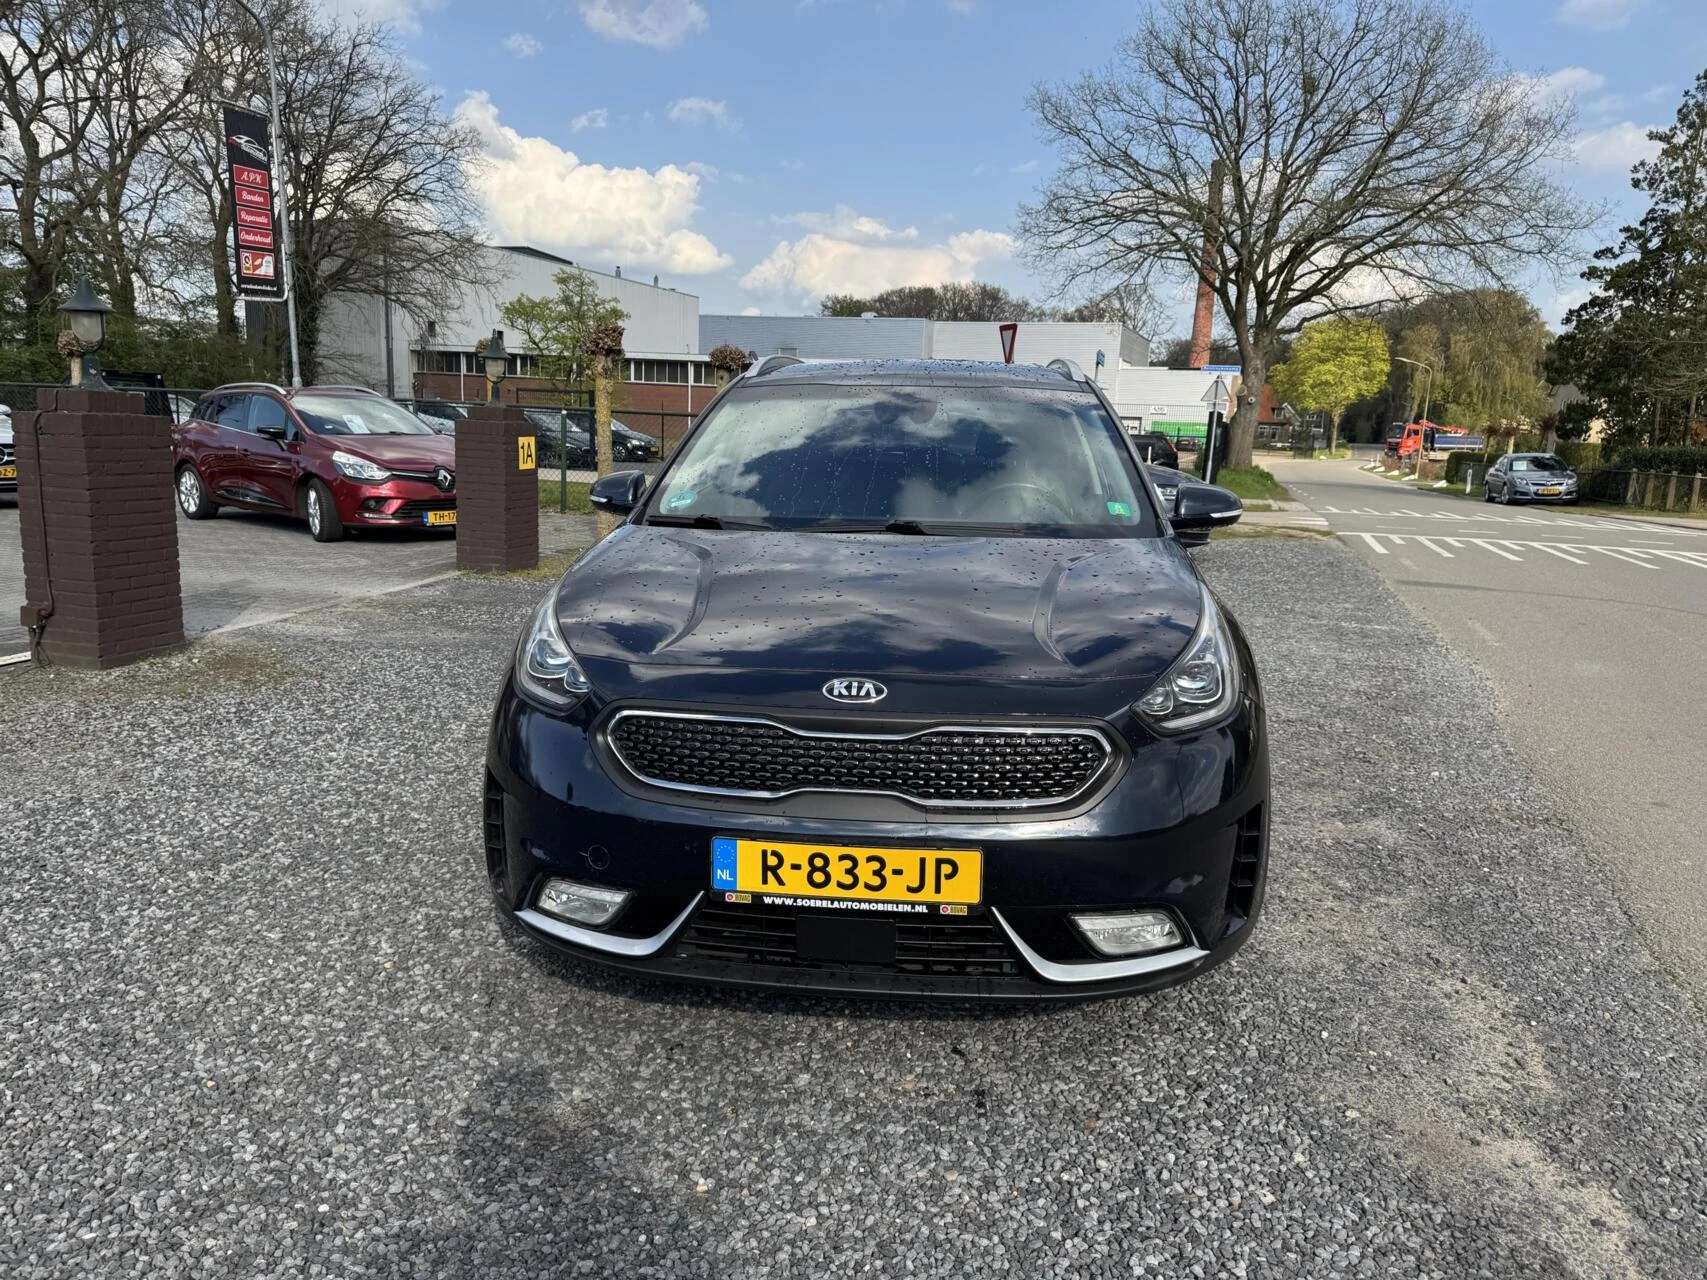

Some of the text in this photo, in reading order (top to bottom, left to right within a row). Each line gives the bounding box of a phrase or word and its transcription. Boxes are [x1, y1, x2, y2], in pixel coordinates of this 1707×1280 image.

[241, 190, 264, 203] Banden
[240, 210, 268, 223] Reparatie
[240, 231, 272, 243] Onderhoud
[520, 442, 534, 465] 1A
[833, 681, 877, 698] KIA
[716, 849, 959, 894] NL R-833-JP
[763, 896, 929, 914] WWW.SOERELAUTOMOBIELEN.NL
[950, 905, 967, 915] BOVAG
